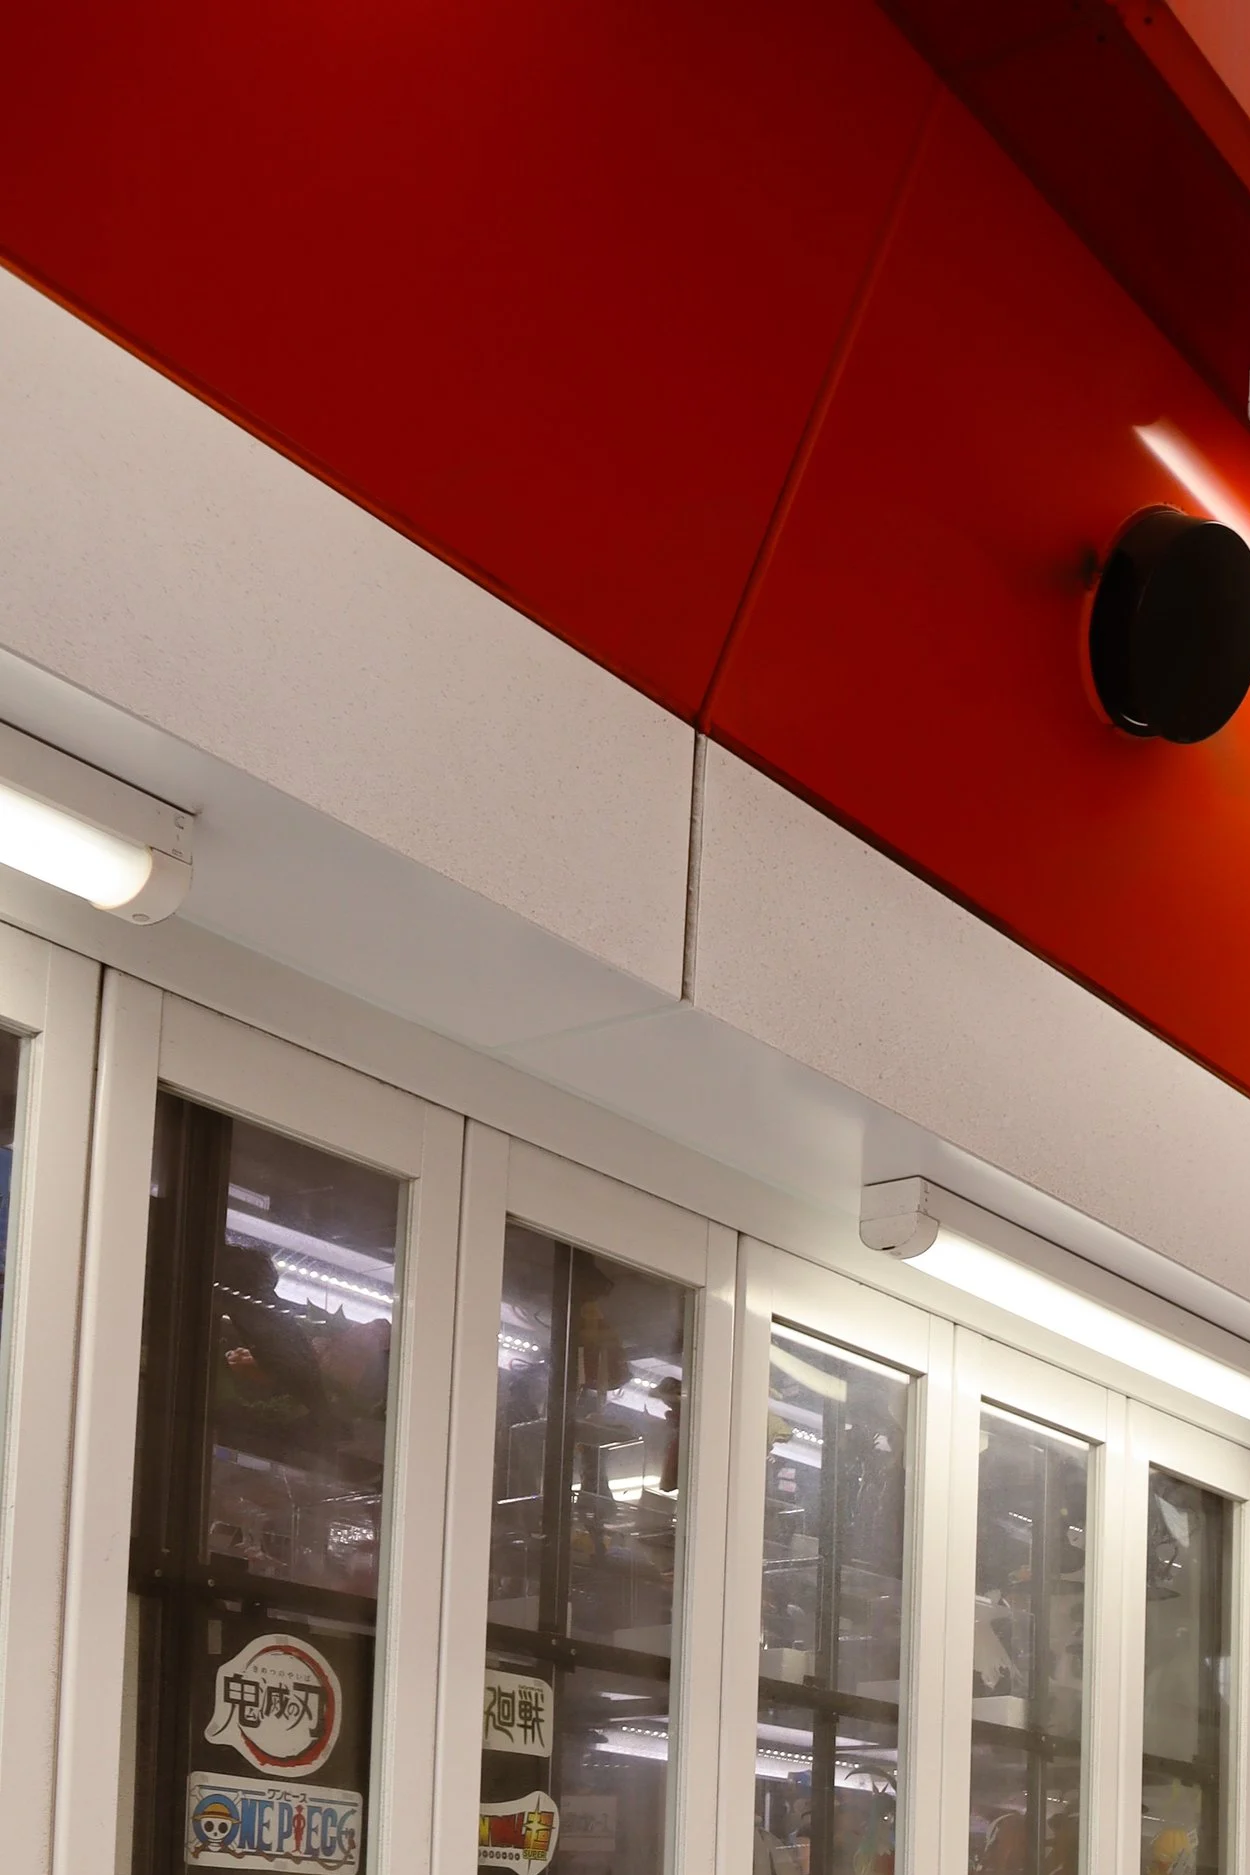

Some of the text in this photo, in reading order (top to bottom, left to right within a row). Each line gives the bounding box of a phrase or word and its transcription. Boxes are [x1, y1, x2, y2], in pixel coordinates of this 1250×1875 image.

[212, 1673, 327, 1738] 鬼滅の刃
[192, 1793, 358, 1861] ONE PIECE
[267, 1788, 308, 1803] ワンピース
